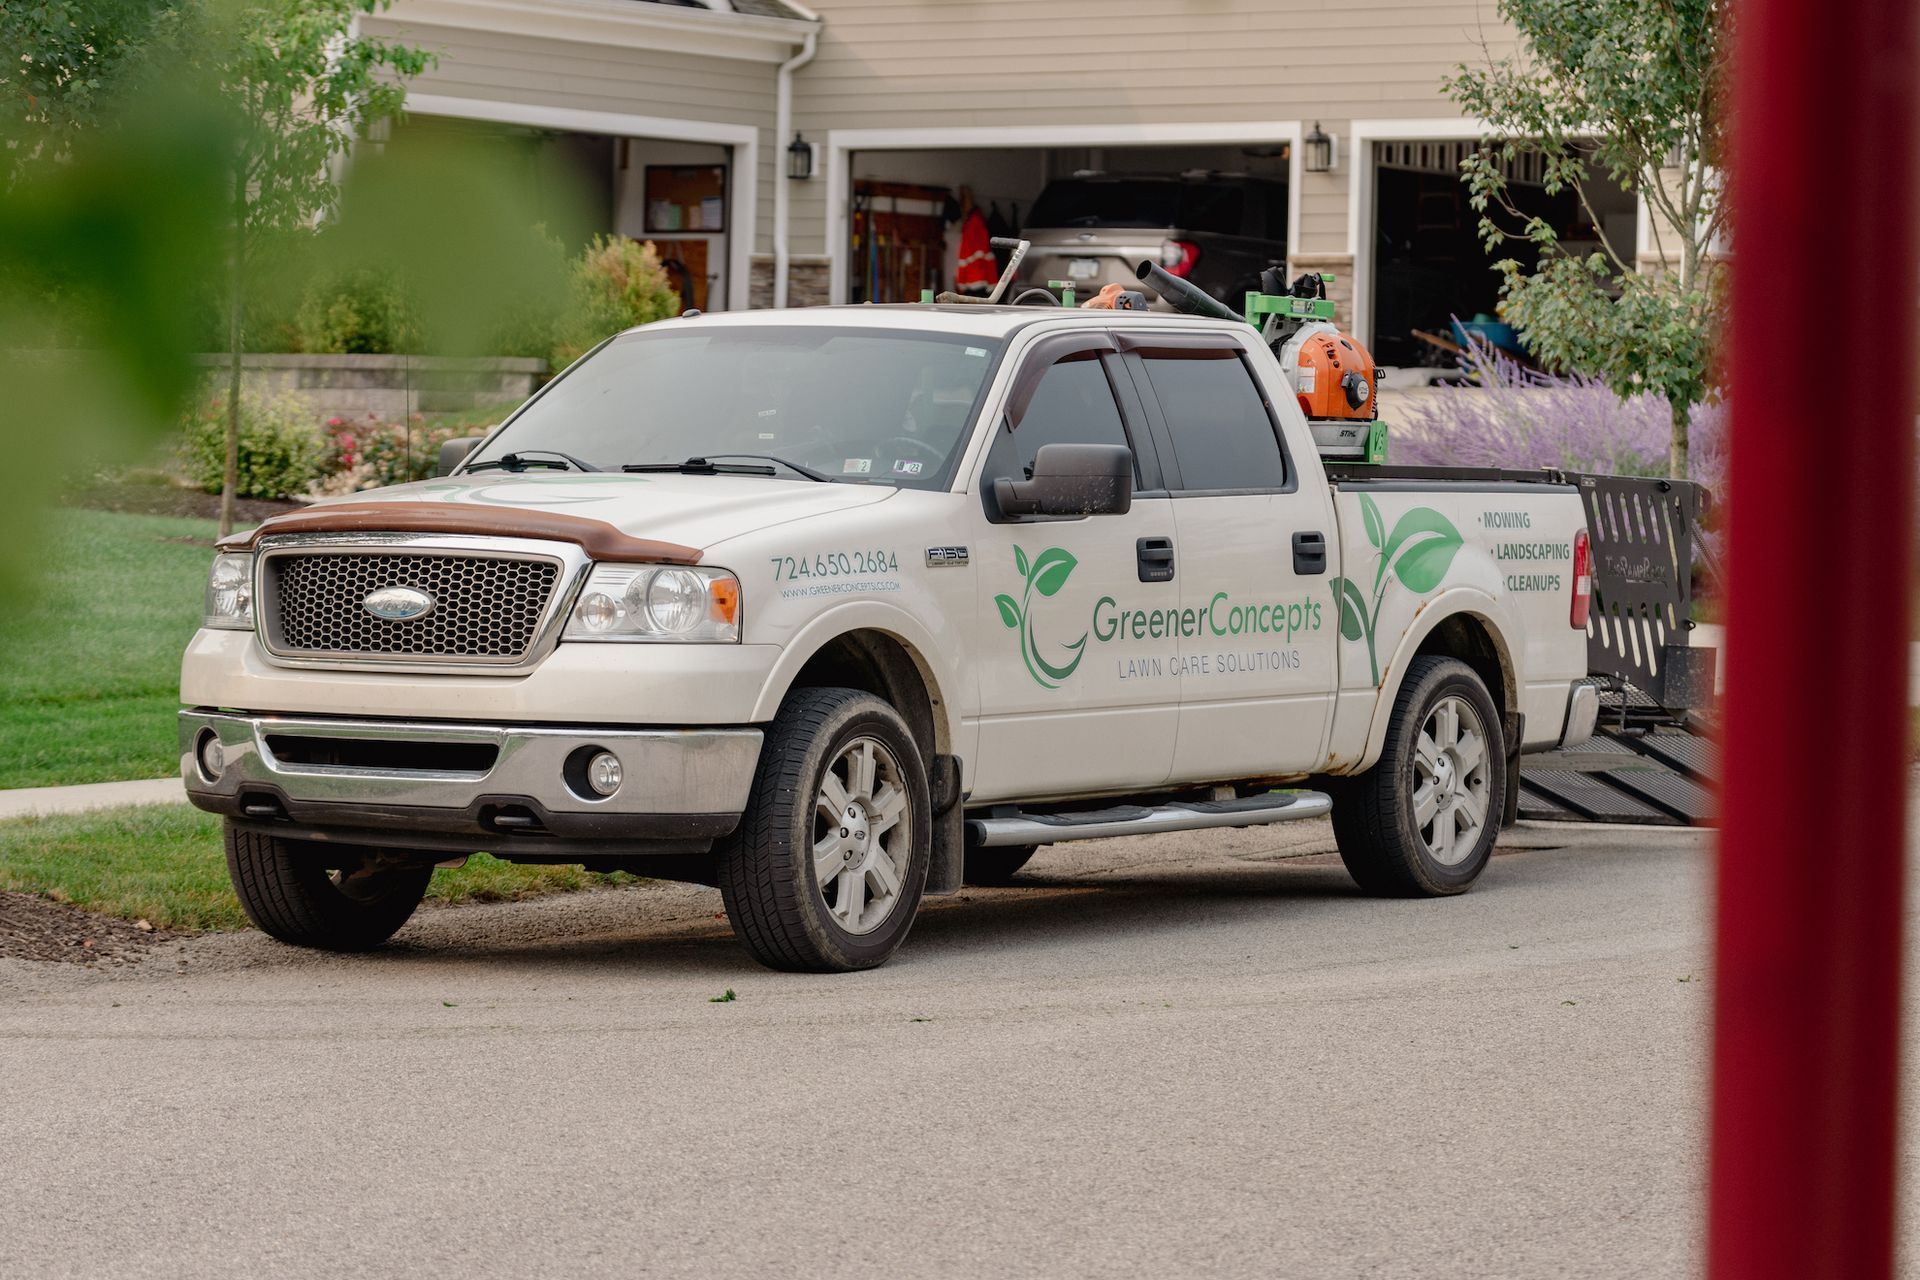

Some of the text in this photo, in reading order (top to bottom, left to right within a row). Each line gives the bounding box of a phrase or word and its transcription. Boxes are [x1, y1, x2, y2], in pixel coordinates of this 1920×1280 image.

[1484, 512, 1531, 529] MOWING
[1497, 543, 1570, 560] LANDSCAPING
[771, 550, 899, 581] 724.650.2684
[1507, 575, 1560, 591] CLEANUPS
[1093, 592, 1322, 643] GreenerConcepts
[1118, 650, 1301, 678] LAWN CARE SOLUTIONS
